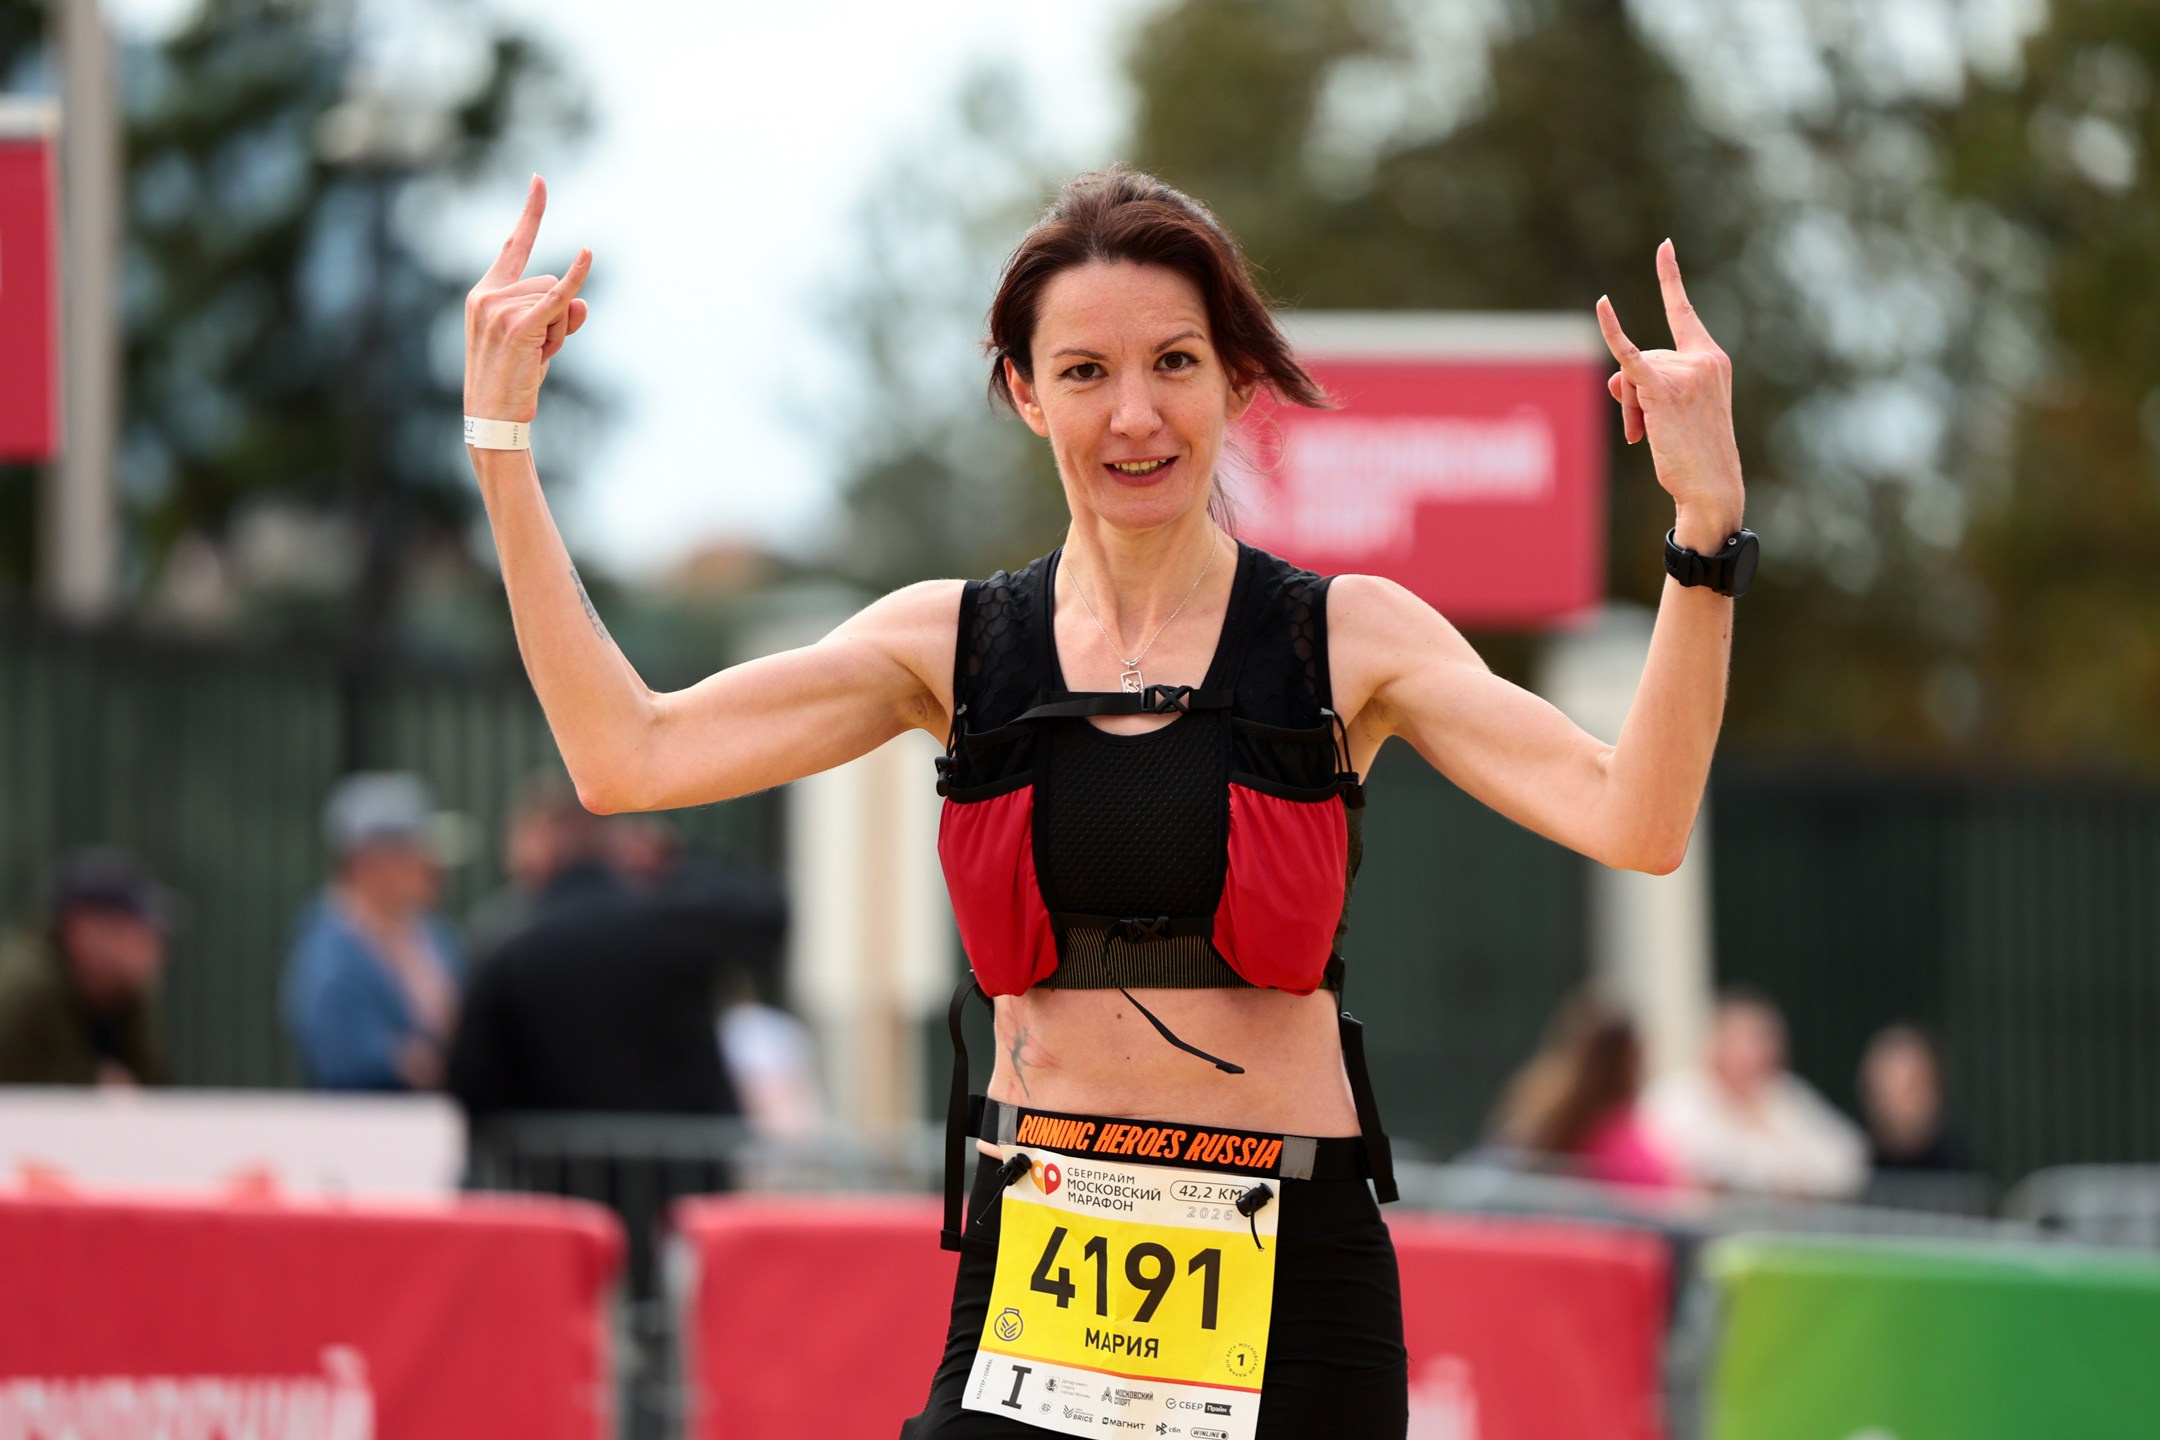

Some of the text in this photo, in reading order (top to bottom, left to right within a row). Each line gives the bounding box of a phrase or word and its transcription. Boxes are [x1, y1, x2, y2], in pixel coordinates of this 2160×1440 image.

[1016, 1114, 1283, 1169] RUNNING HEROES RUSSIA
[1067, 1167, 1135, 1184] СБЕРПРАЙМ
[1067, 1178, 1161, 1201] МОСКОВСКИЙ
[1179, 1185, 1212, 1200] 42,2
[1068, 1191, 1134, 1212] МАРАФОН
[1187, 1206, 1233, 1221] 2026
[1030, 1226, 1221, 1330] 4191
[1085, 1327, 1159, 1358] МАРИЯ
[1237, 1353, 1245, 1366] 1
[1001, 1364, 1032, 1410] I
[1115, 1388, 1154, 1401] МОСКОВСКИЙ
[1113, 1397, 1131, 1407] СПОРТ
[1179, 1401, 1203, 1411] СБЕР
[1073, 1413, 1093, 1423] BRICS
[1109, 1419, 1145, 1430] магнит
[1193, 1429, 1220, 1438] WINLINE
